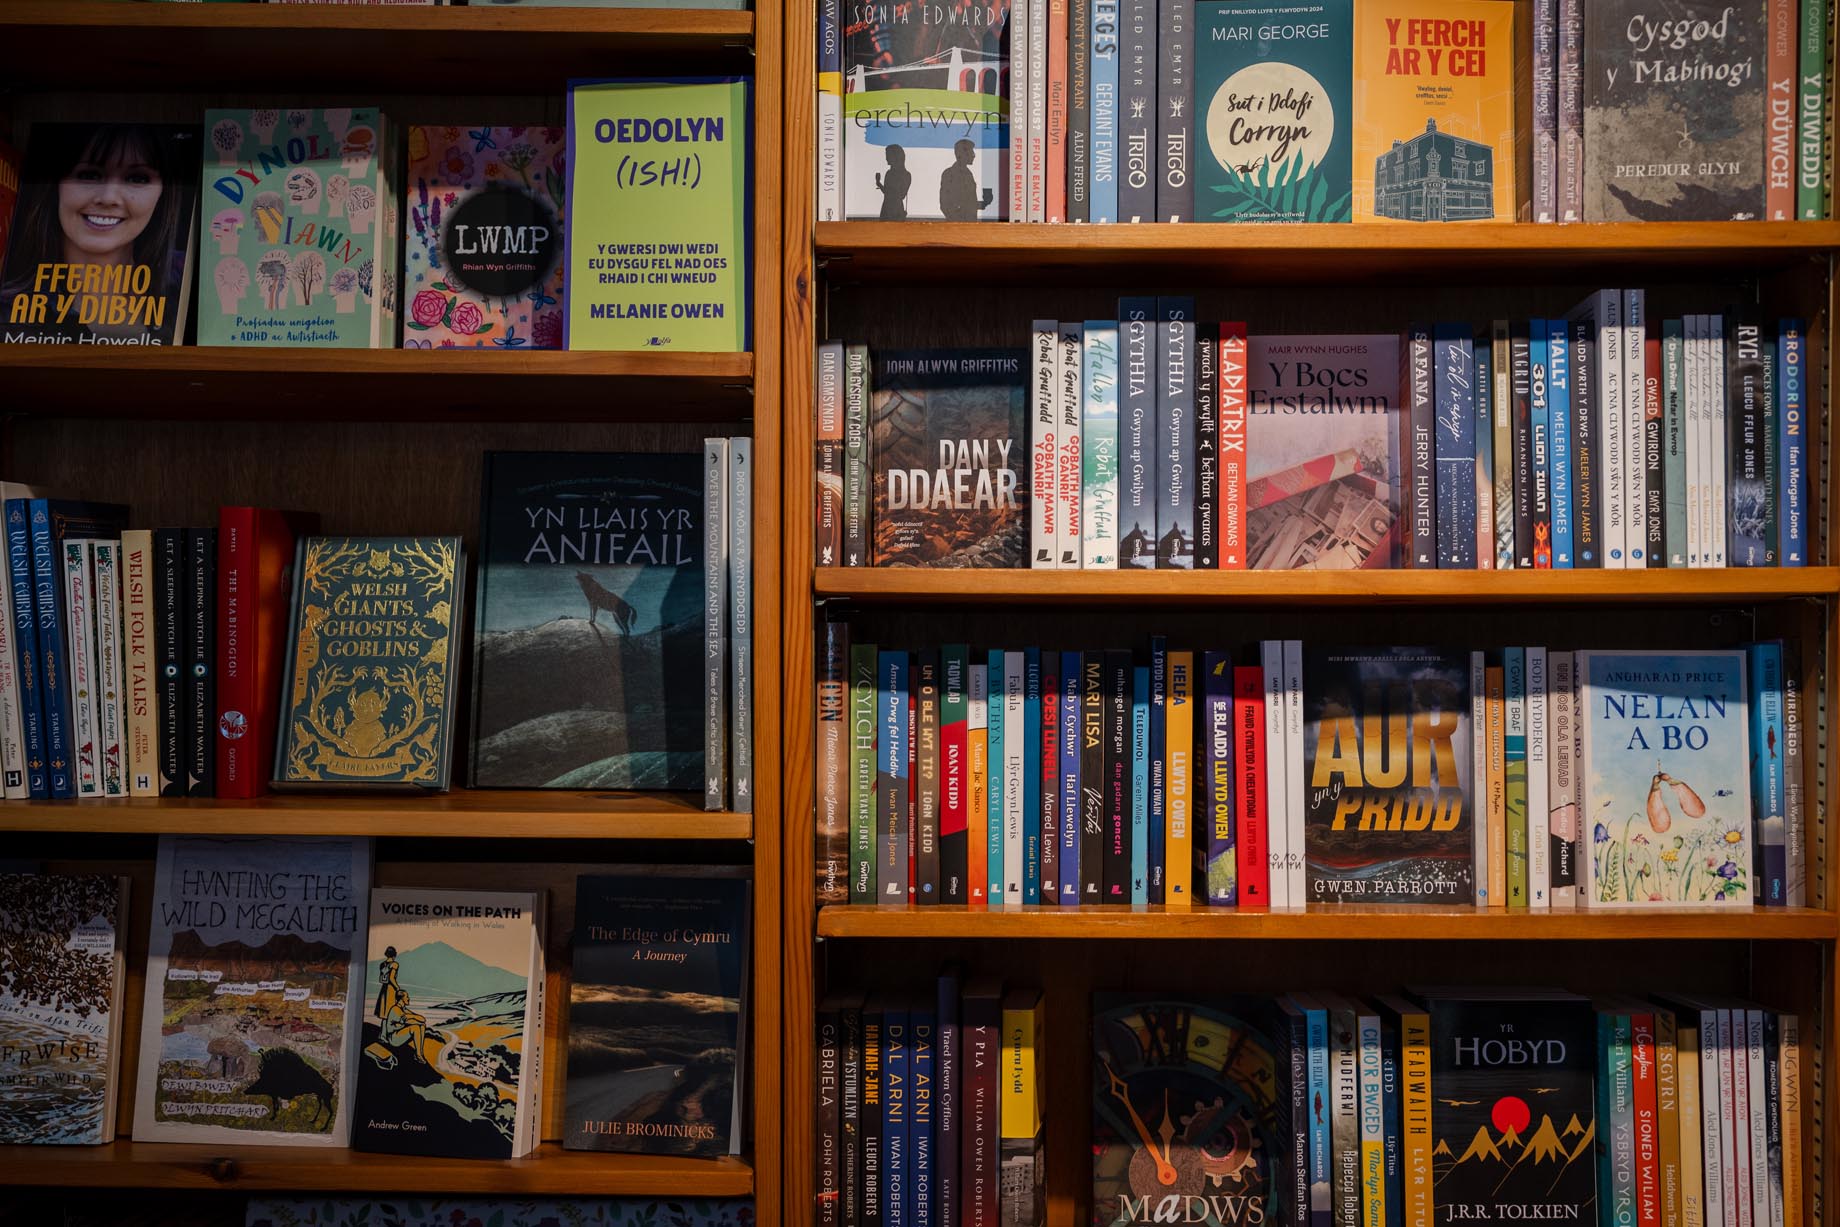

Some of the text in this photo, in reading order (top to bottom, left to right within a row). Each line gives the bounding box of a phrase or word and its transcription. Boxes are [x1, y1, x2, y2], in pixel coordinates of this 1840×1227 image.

[854, 5, 1008, 26] SONIA EDWARDS
[1627, 7, 1734, 52] Cysgod
[825, 22, 834, 55] AGOS
[1212, 24, 1329, 41] MARI GEORGE
[1385, 19, 1485, 48] Y FERCH
[1385, 48, 1485, 76] AR Y CEI
[1607, 57, 1752, 91] y Mabinogi
[1802, 7, 1822, 189] GOWER Y DIWEDD
[855, 102, 1003, 137] erchwyn
[1050, 81, 1062, 145] Mari Emlyn
[1128, 45, 1147, 188] EMYR TRIGO
[595, 117, 724, 142] OEDOLYN
[1229, 118, 1312, 163] Corryn
[213, 134, 329, 204] DYNOL
[616, 152, 702, 190] (ISH!)
[1614, 162, 1740, 178] PEREDUR GLYN
[283, 216, 362, 264] IAWN
[455, 224, 550, 255] LWMP
[598, 243, 719, 255] Y GWERSI DWI WEDI
[589, 257, 727, 269] EU DYSGU FEL NAD OES
[34, 263, 151, 295] FFERMIO
[599, 273, 638, 284] RHAID
[647, 273, 667, 284] CHI
[671, 273, 717, 284] WNEUD
[10, 295, 167, 326] AR Y DIBYN
[590, 304, 724, 319] MELANIE OWEN
[1268, 345, 1368, 354] MAIR WYNN HUGHES
[887, 359, 1018, 375] JOHN ALWYN GRIFFITHS
[1269, 362, 1368, 387] Y Bocs
[1250, 388, 1389, 414] Erstalwm
[1222, 336, 1244, 546] GLADIATRIX BETHAN GWANAS
[1415, 333, 1429, 536] SAFANA JERRY HUNTER
[1551, 332, 1567, 534] HALLT MELERI WYN JAMES
[940, 439, 1013, 470] DAN Y
[709, 470, 719, 497] OVER
[888, 469, 1017, 510] DDAEAR
[524, 507, 695, 531] YN LLAIS YR
[709, 499, 719, 521] THE
[523, 532, 694, 566] ANIFAIL
[351, 582, 408, 596] WELSH
[709, 591, 718, 614] AND
[334, 599, 418, 617] GIANTS,
[130, 550, 147, 717] WELSH FOLK TALES
[228, 569, 238, 678] THE MABINOGION
[323, 620, 437, 638] GHOSTS &
[709, 617, 718, 637] THE
[327, 640, 420, 658] GOBLINS
[709, 640, 718, 658] SEA
[1606, 672, 1725, 682] ANGHARAD PRICE
[1604, 694, 1726, 719] NELAN
[27, 712, 38, 750] STARLING
[51, 712, 60, 750] STARLING
[947, 659, 960, 810] TADWLAD IOAN KIDD
[1627, 725, 1708, 750] A BO
[1172, 665, 1186, 838] HELFA LLWYD OWEN
[1214, 714, 1228, 840] BLAIDD LLWYD OWEN
[1043, 729, 1056, 864] LLINELL Mared Lewis
[1331, 789, 1463, 831] PRIDD
[1315, 881, 1457, 894] GWEN PARROTT
[161, 902, 358, 932] WILD MEGALITH
[382, 903, 521, 919] VOICES ON THE PATH
[590, 927, 730, 945] The Edge of Cymru
[632, 950, 687, 963] A Journey
[1499, 1023, 1514, 1033] YR
[1453, 1037, 1567, 1066] HOBYD
[163, 1080, 235, 1092] DEWI BOWEN
[368, 1119, 427, 1132] Andrew Green
[582, 1120, 715, 1139] JULIE BROMINICKS
[822, 1024, 834, 1223] GABRIELA JOHN ROBERTS
[864, 1024, 879, 1216] HANNAH-JANE LLEUCU ROBERTS
[888, 1025, 903, 1227] DAL ARNI IWAN ROBERT
[1615, 1027, 1630, 1213] Mari Williams YSBRYD YR
[1118, 1194, 1265, 1223] MaDWS
[1446, 1203, 1578, 1222] J.R.R. TOLKIEN
